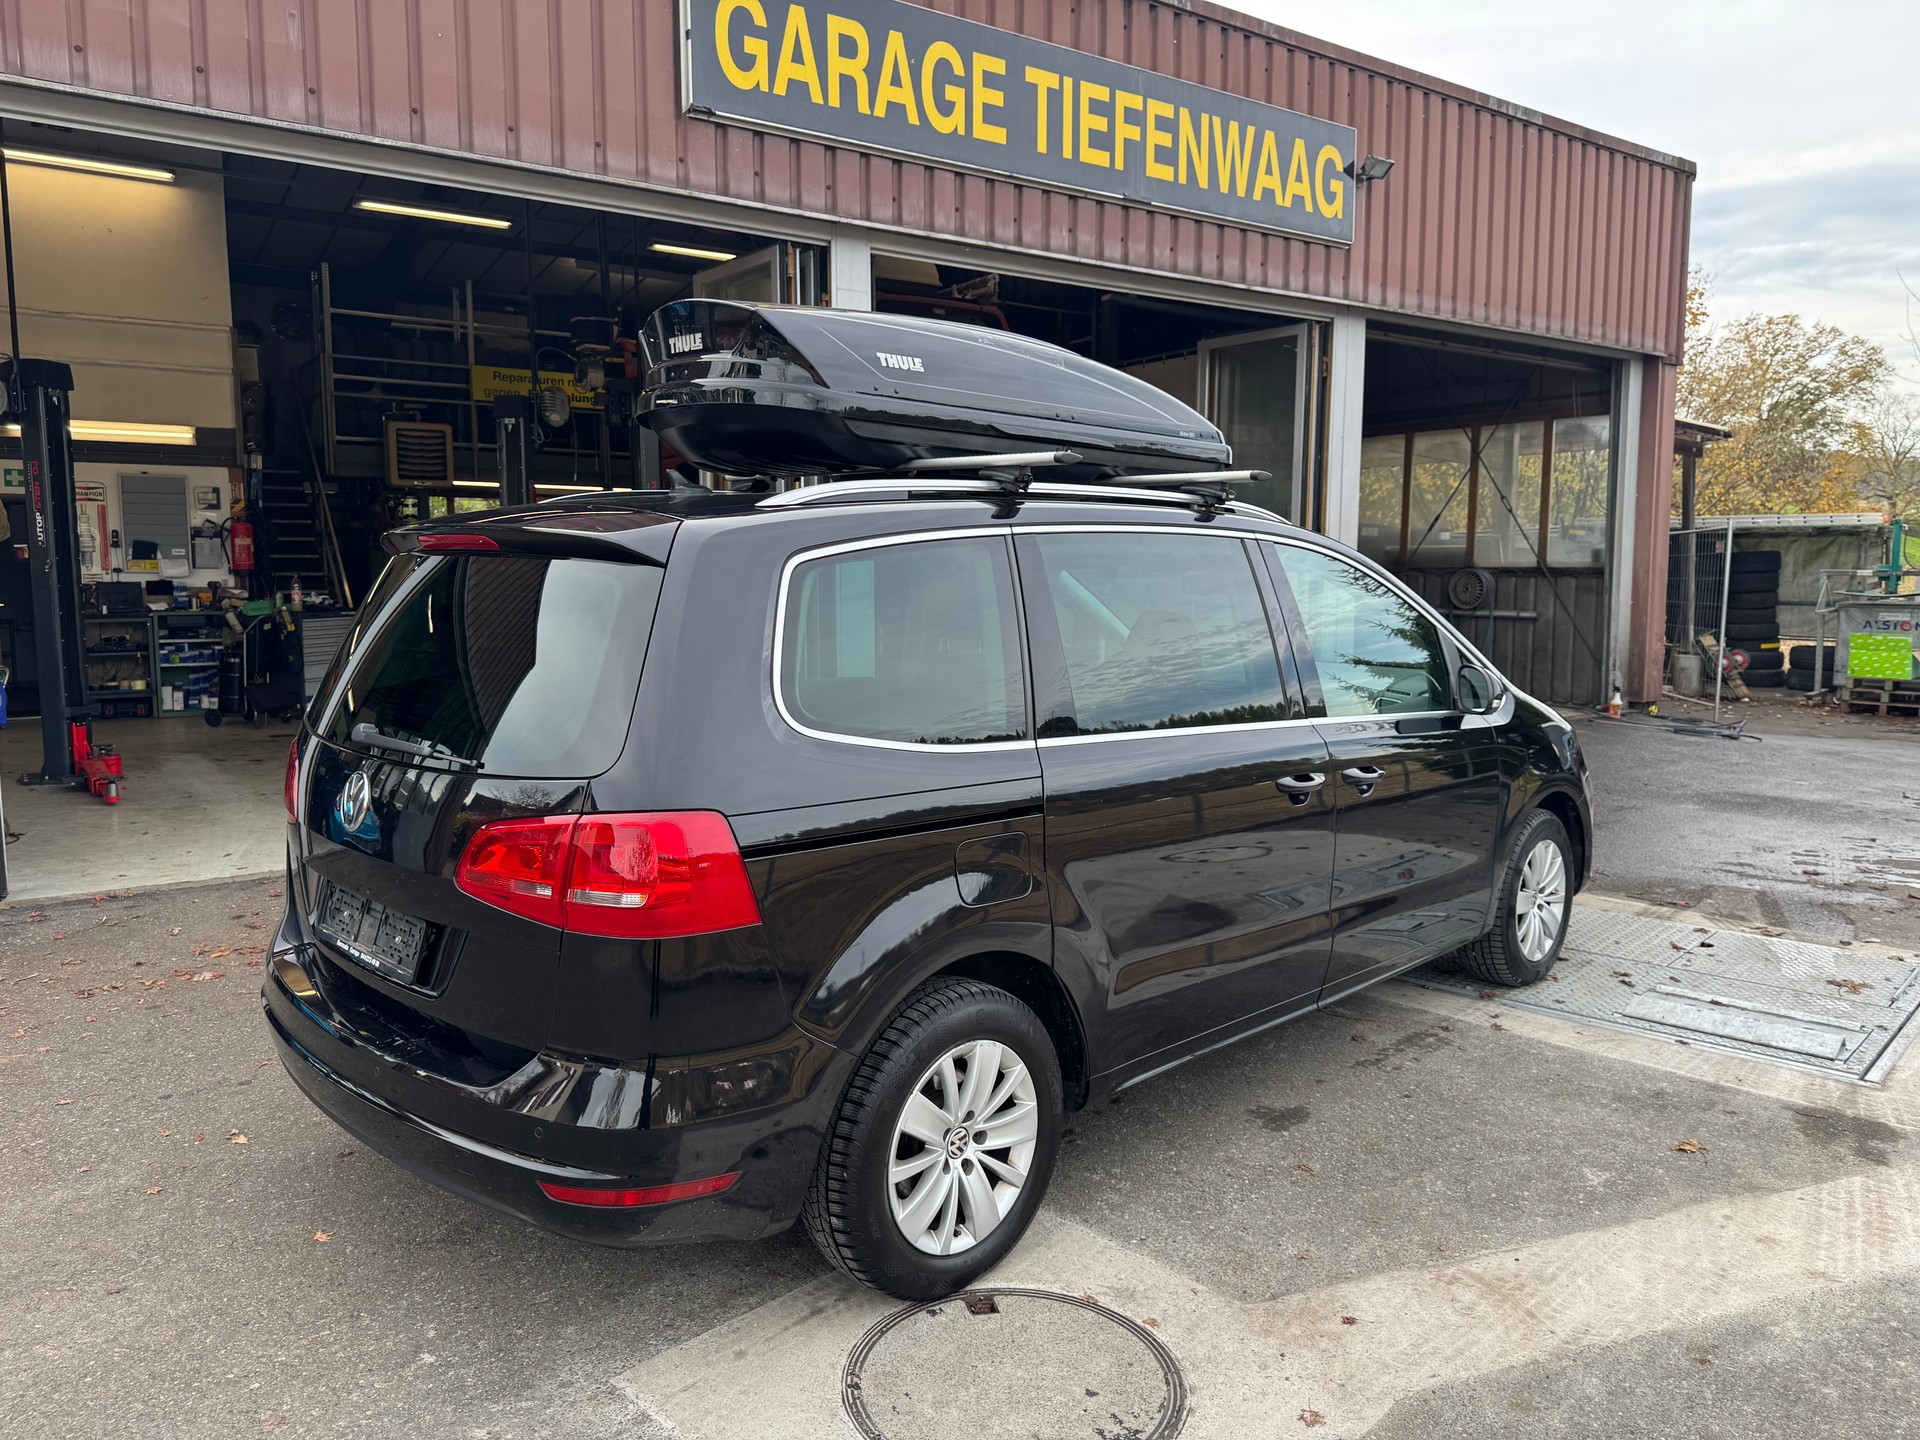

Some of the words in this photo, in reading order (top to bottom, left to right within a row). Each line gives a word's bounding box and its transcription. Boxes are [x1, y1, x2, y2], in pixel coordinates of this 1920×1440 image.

[715, 0, 1008, 145] GARAGE
[1024, 65, 1345, 220] TIEFENWAAG
[668, 332, 704, 355] THULE
[875, 351, 925, 373] THULE
[493, 371, 565, 386] Reparauren
